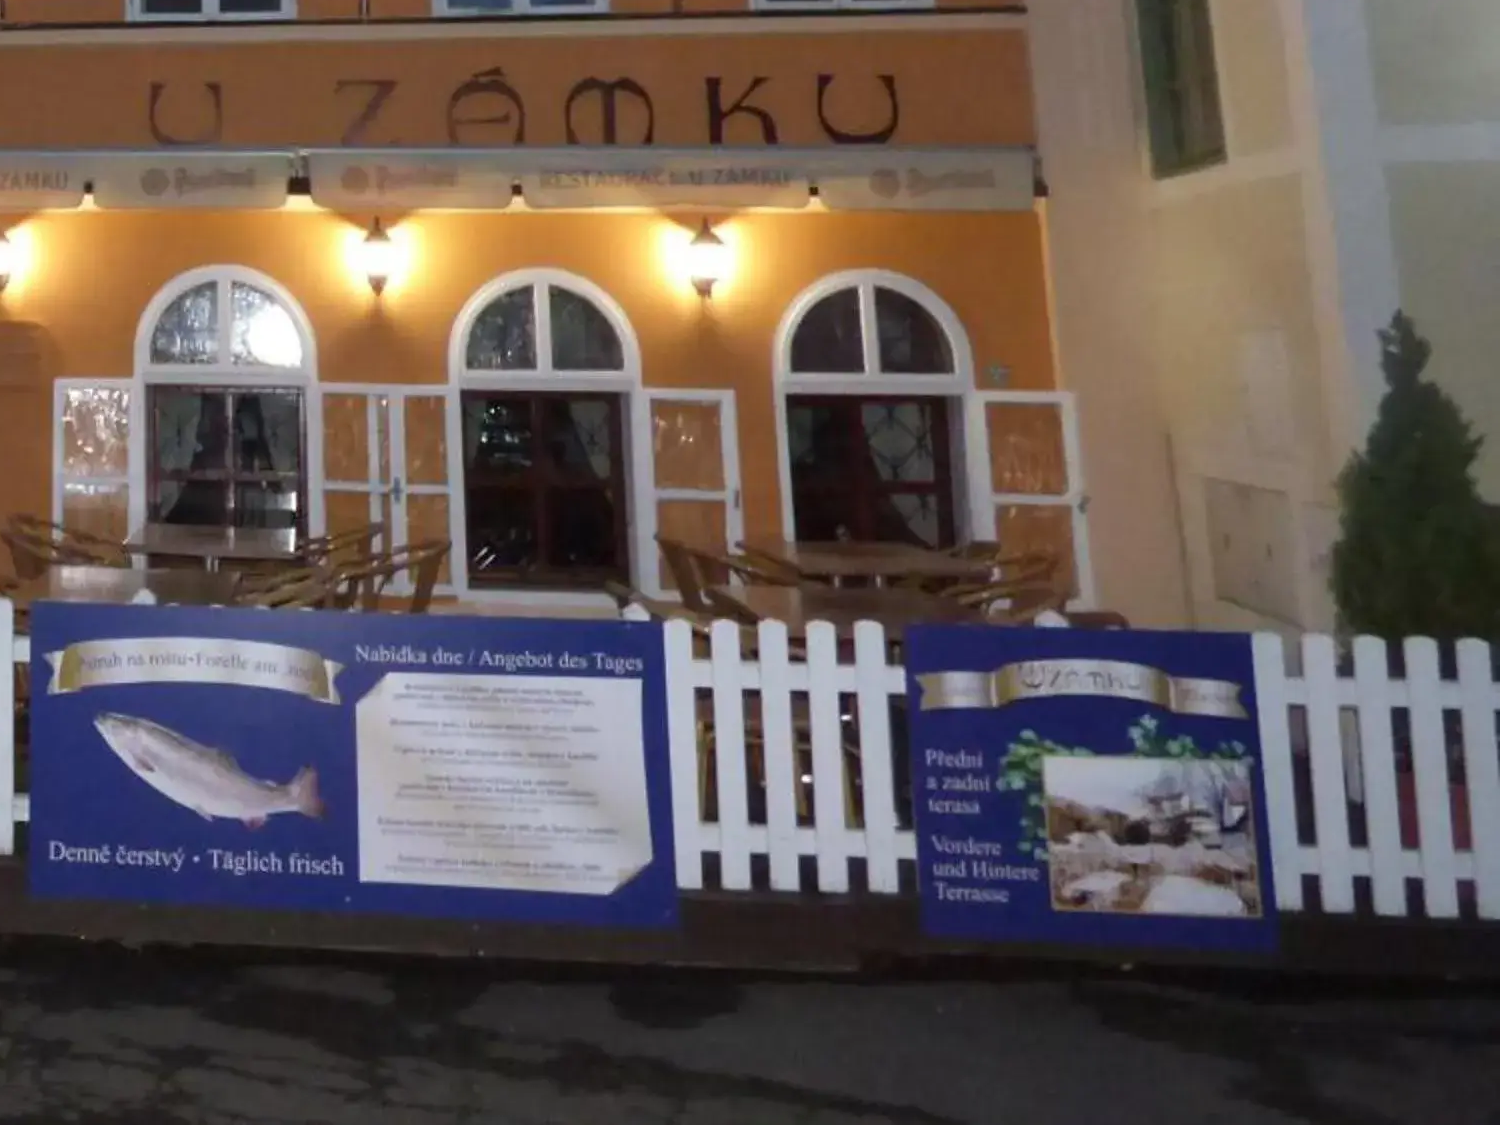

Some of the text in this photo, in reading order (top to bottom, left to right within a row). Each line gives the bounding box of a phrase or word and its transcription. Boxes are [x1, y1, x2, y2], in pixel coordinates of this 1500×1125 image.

[149, 81, 223, 145] U
[431, 645, 464, 667] dne
[478, 648, 554, 673] Angebot
[558, 650, 589, 670] des
[593, 651, 644, 674] Tages
[48, 839, 345, 876] Denně čerstvý Täglich frisch
[930, 833, 1002, 856] Vordere
[932, 858, 967, 878] und
[932, 880, 1011, 904] Terrasse
